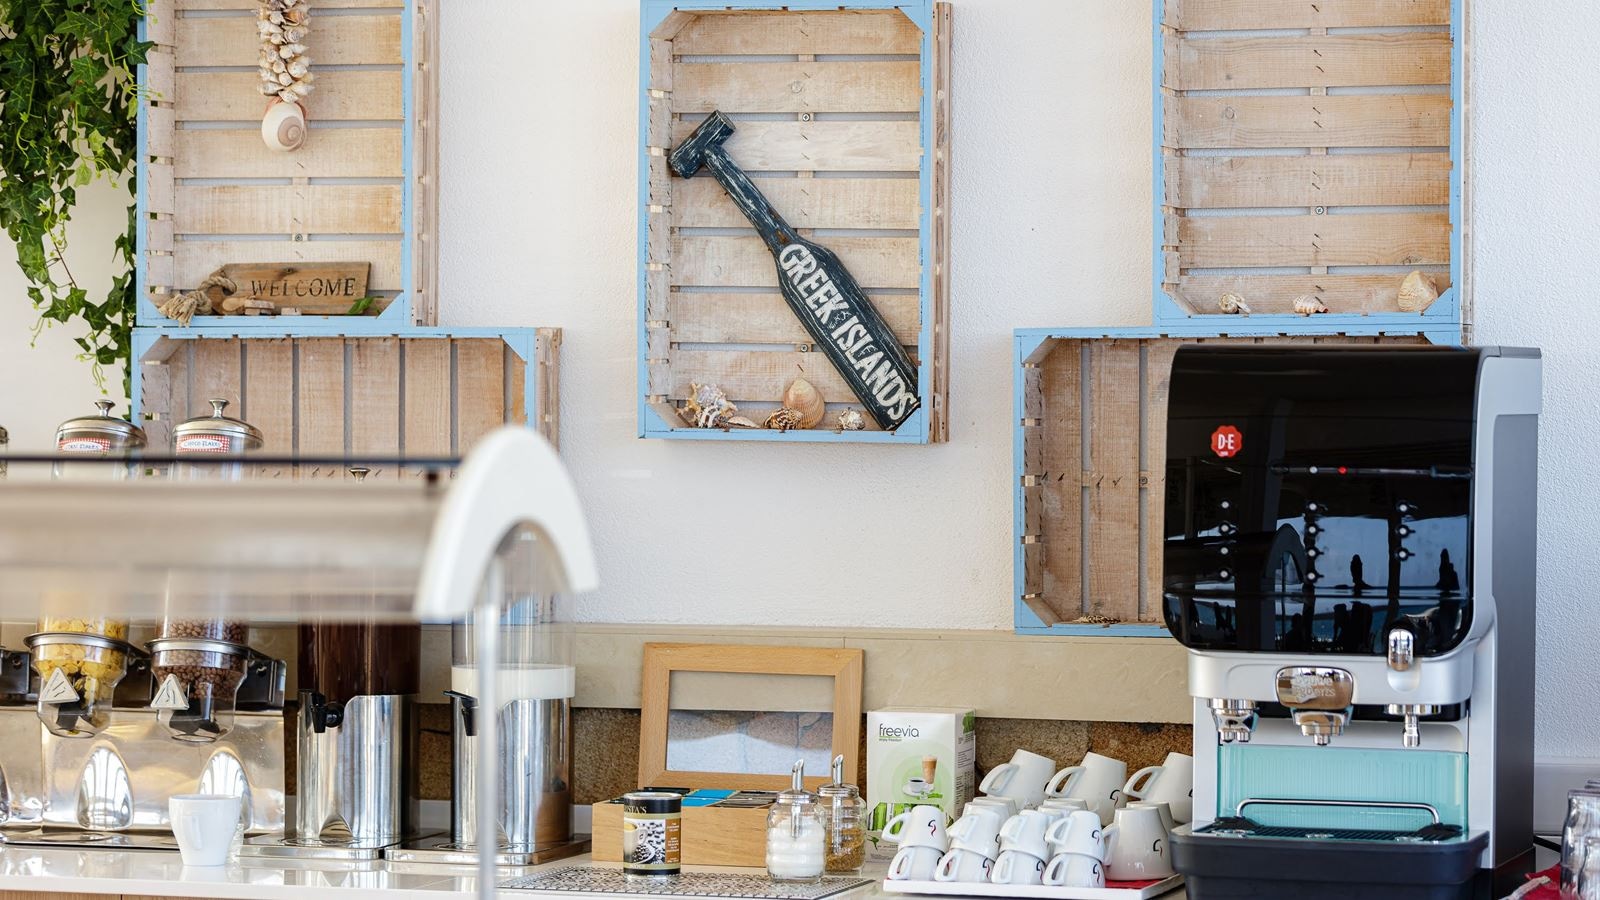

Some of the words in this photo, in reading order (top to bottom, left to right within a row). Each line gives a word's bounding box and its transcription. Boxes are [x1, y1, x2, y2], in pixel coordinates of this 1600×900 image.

[251, 277, 356, 297] WELCOME
[779, 243, 849, 325] GREEK
[830, 315, 918, 421] ISLANDS
[879, 723, 920, 738] freevia
